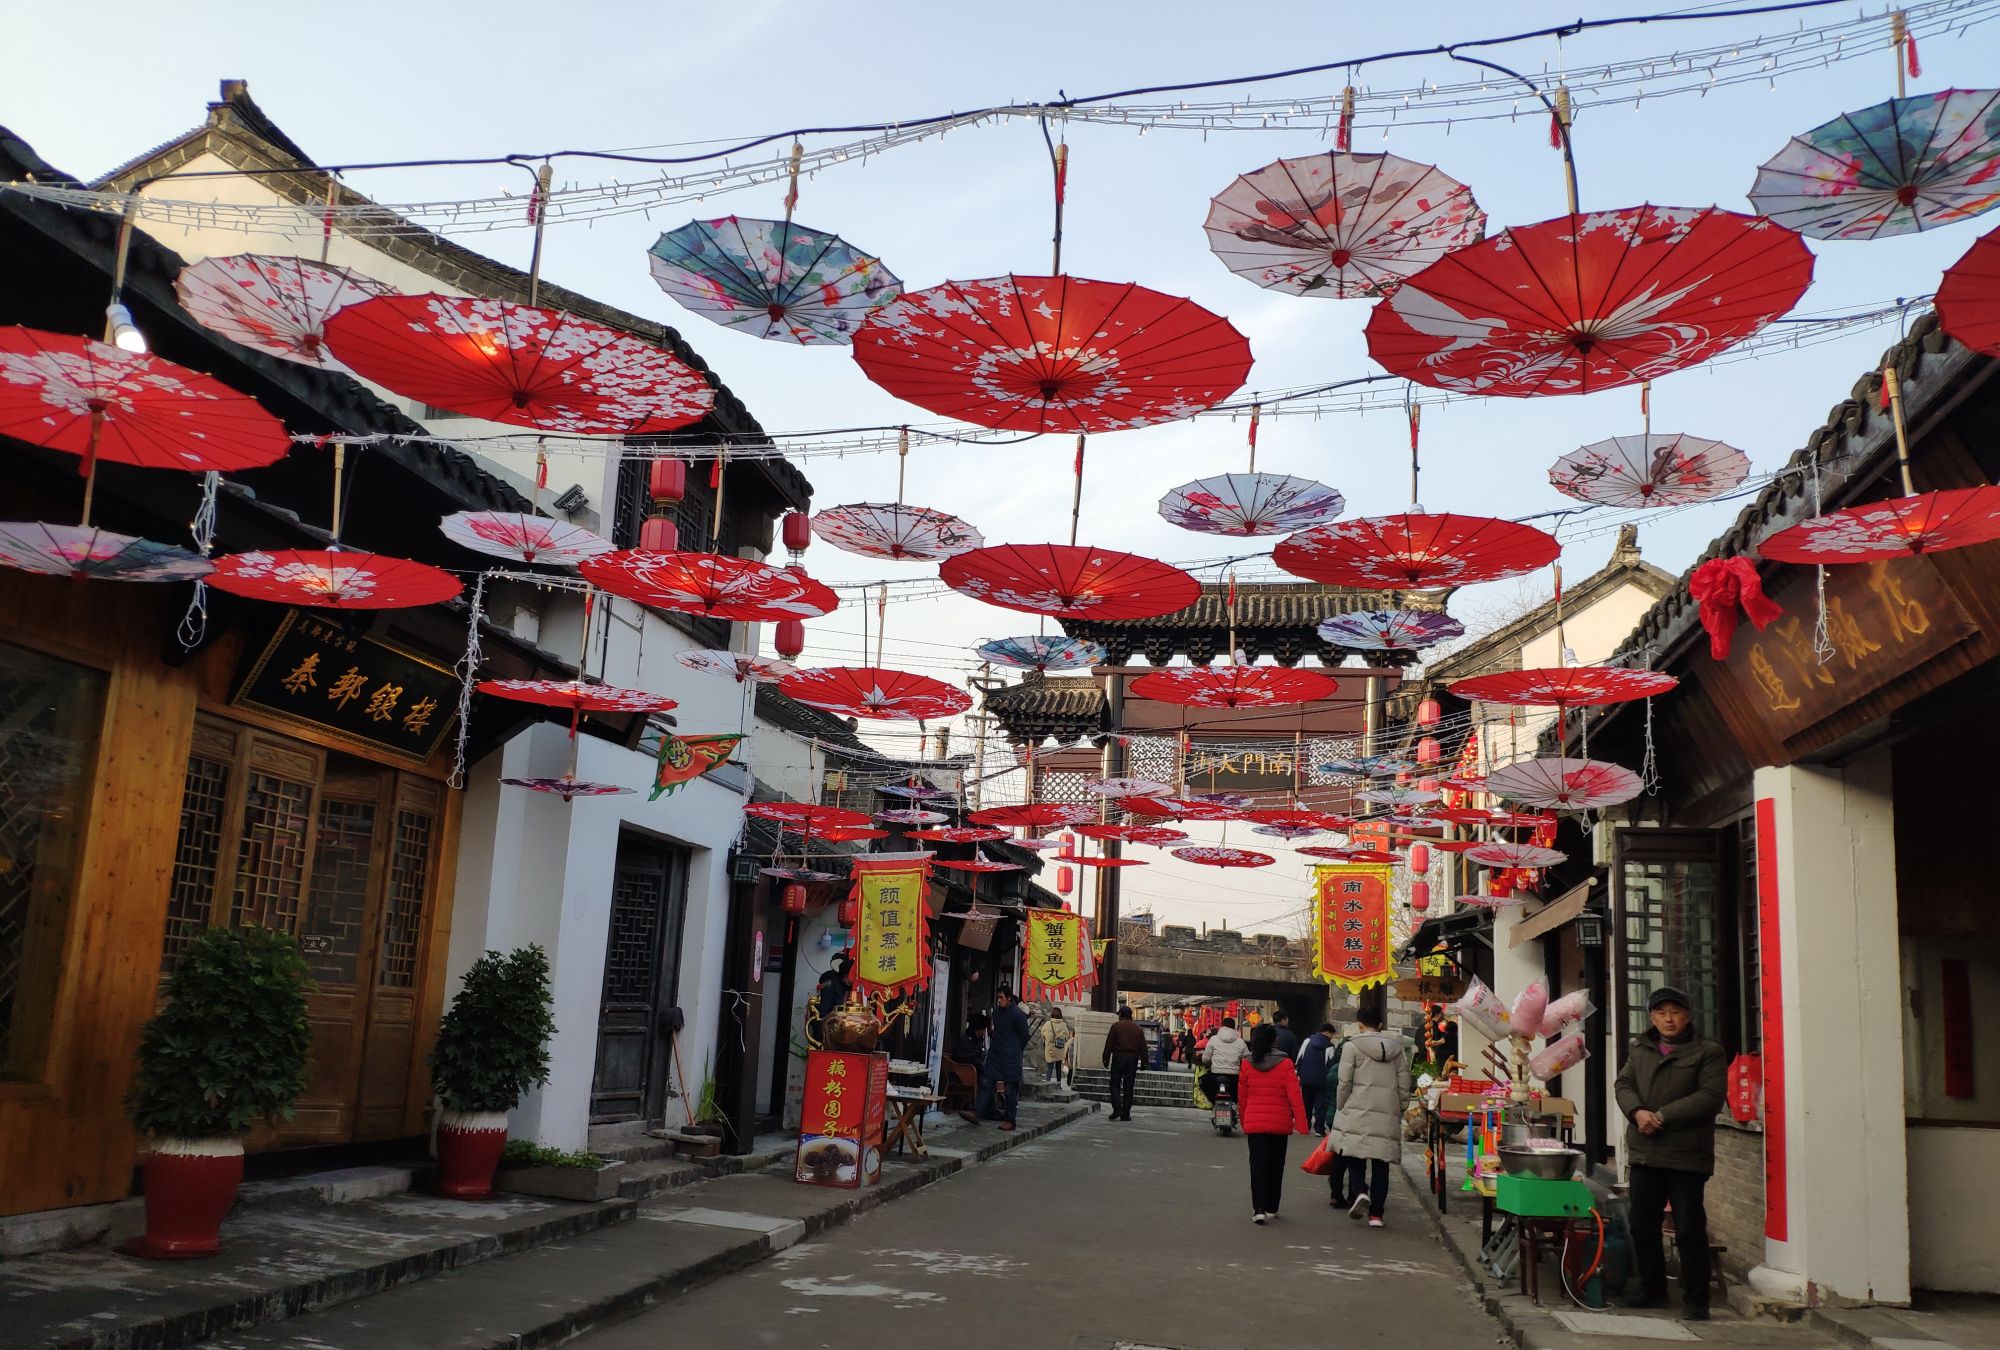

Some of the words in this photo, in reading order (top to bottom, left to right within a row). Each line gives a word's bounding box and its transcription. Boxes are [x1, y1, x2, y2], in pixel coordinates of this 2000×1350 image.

[878, 887, 901, 972] 颜值蒸糕
[1043, 922, 1066, 980] 蟹黄鱼丸
[1343, 881, 1364, 970] 南水关糕点
